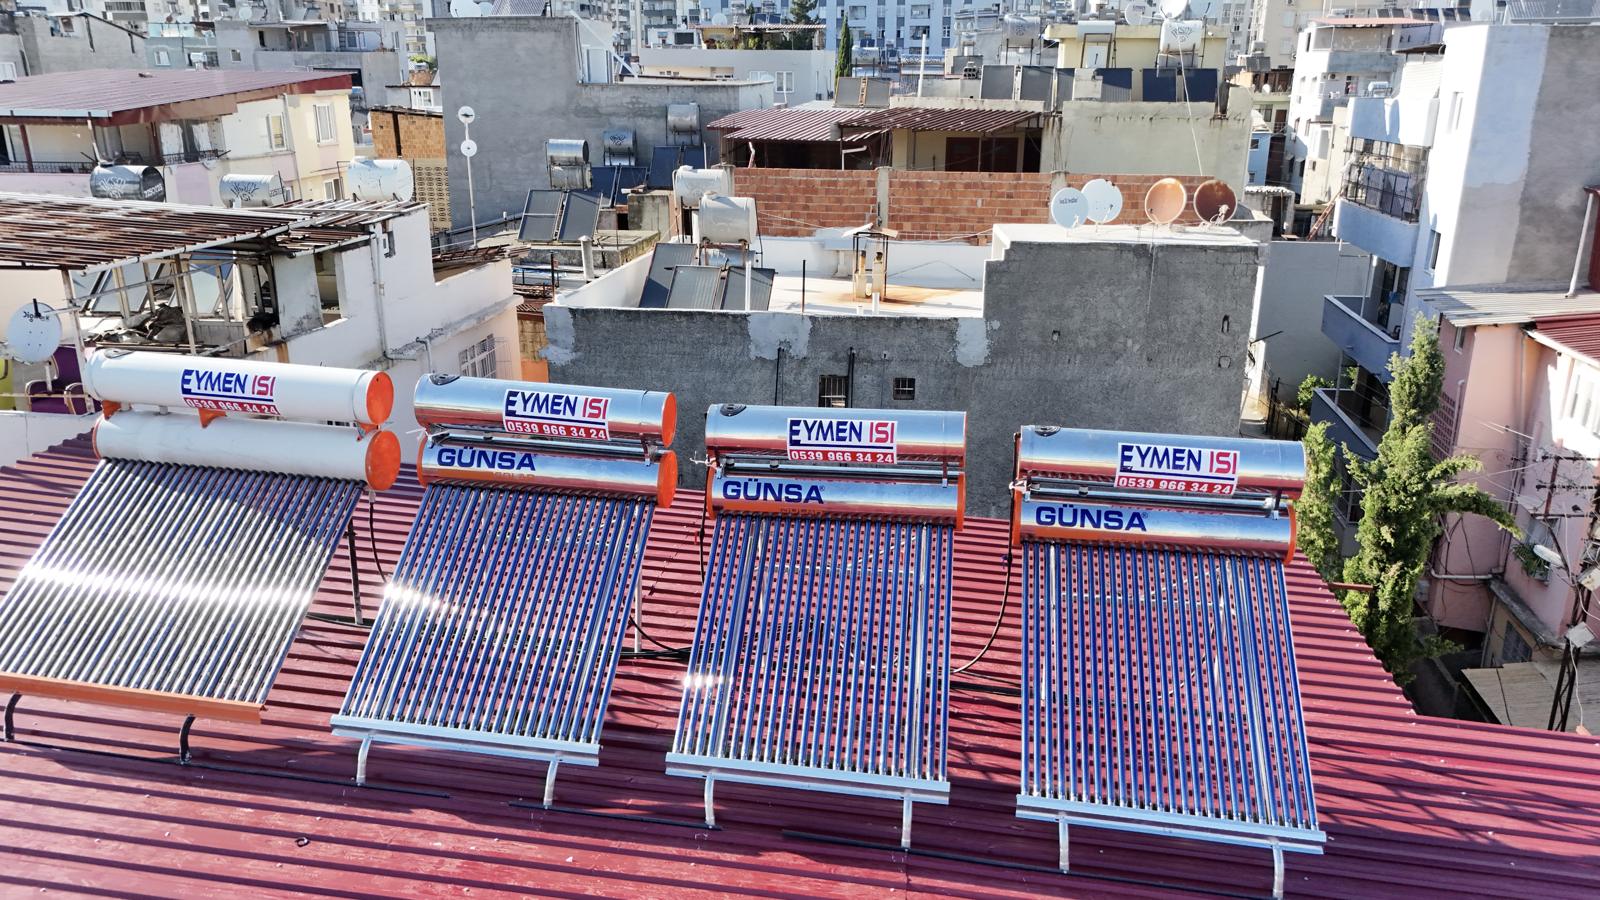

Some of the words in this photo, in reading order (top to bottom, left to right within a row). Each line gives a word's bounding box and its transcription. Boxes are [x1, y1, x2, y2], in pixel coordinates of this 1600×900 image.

[181, 369, 248, 394] EYMEN
[251, 375, 276, 397] ISI
[186, 399, 217, 410] 0539
[218, 401, 241, 411] 966
[244, 403, 260, 413] 34
[261, 405, 278, 415] 24
[505, 390, 578, 417] EYMEN
[582, 397, 609, 419] ISI
[507, 421, 539, 433] 0539
[543, 424, 567, 436] 966
[570, 427, 586, 437] 34
[590, 429, 606, 439] 24
[789, 419, 863, 446] EYMEN
[869, 421, 895, 443] ISI
[437, 446, 536, 471] GÜNSA
[791, 450, 823, 460] 0539
[827, 452, 852, 461] 966
[856, 453, 872, 462] 34
[876, 454, 893, 463] 24
[1120, 444, 1202, 472] EYMEN
[1209, 451, 1237, 475] ISI
[722, 478, 824, 504] GÜNSA
[1118, 477, 1155, 488] 0539
[1159, 480, 1186, 490] 966
[1190, 482, 1208, 493] 34
[1212, 484, 1231, 494] 24
[1035, 504, 1147, 532] GÜNSA
